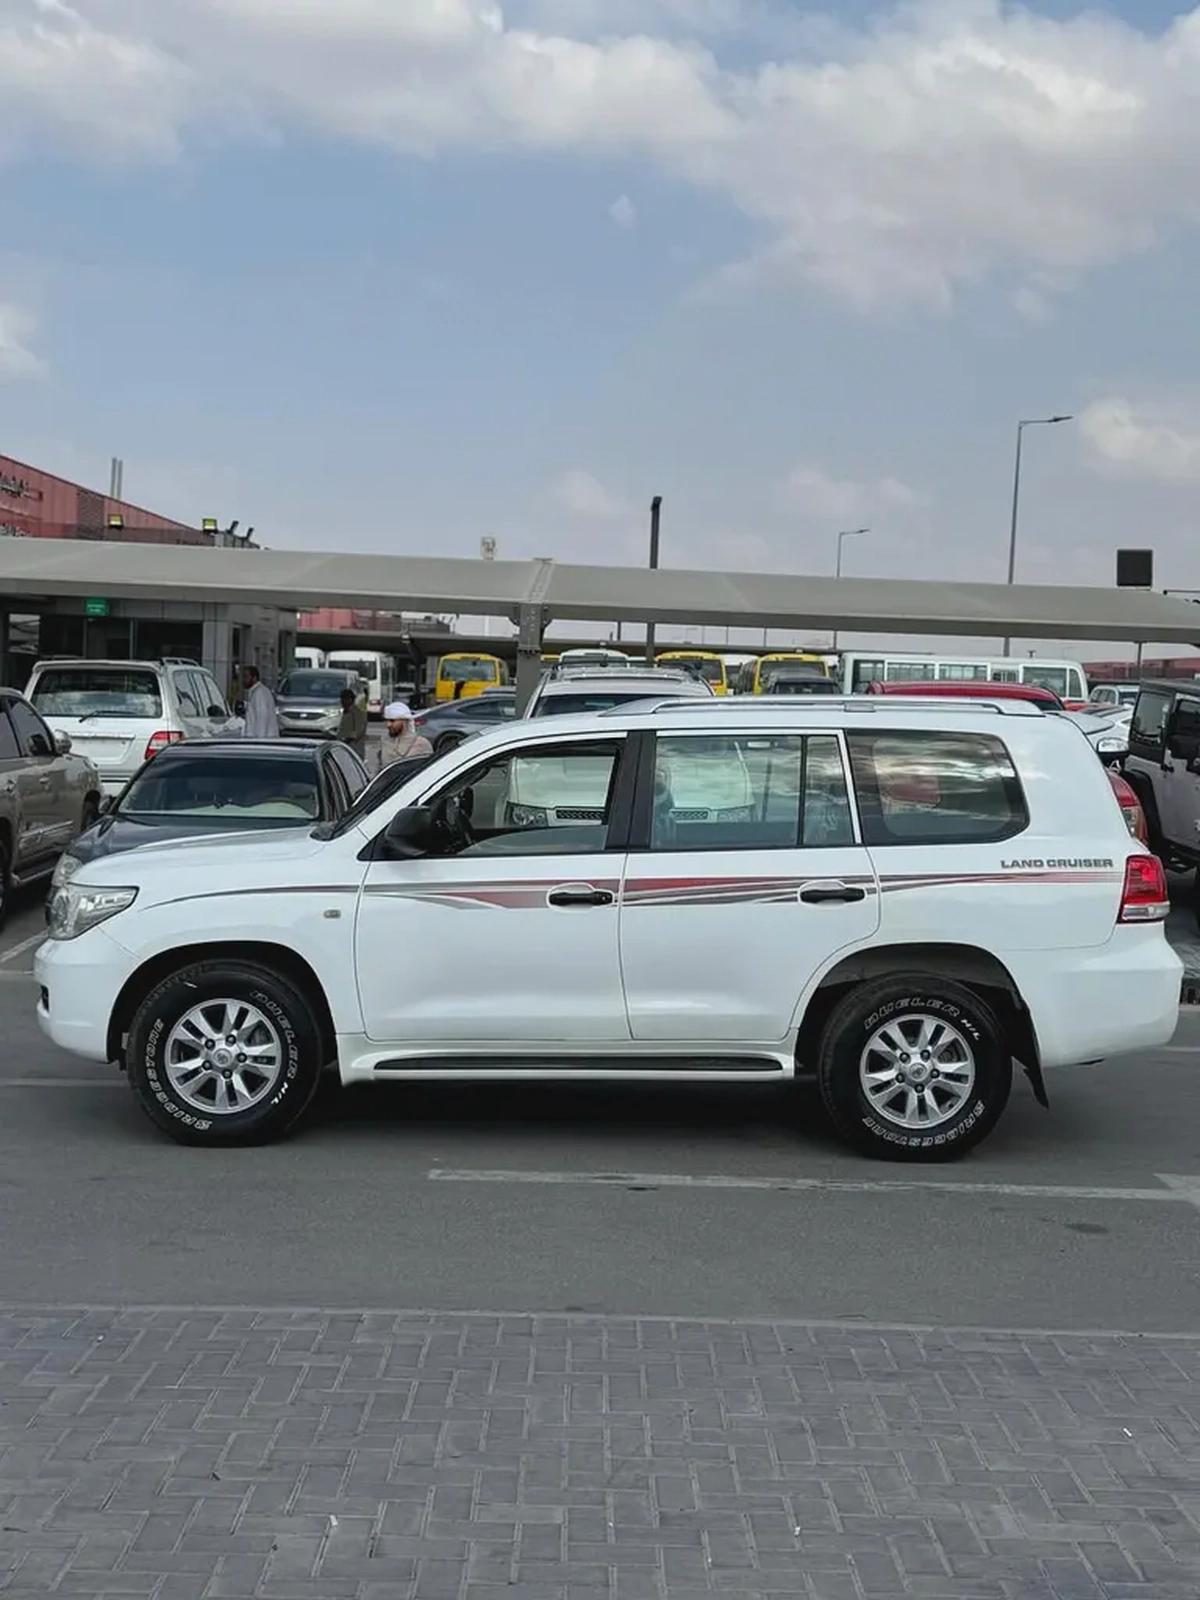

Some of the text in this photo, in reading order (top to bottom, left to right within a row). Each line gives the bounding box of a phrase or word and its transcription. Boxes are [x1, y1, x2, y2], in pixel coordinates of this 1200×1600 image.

[1000, 859, 1114, 869] LAND CRUISER
[146, 1018, 213, 1131] BRIDGESTONE
[861, 1100, 986, 1147] BRIDGESTONE
